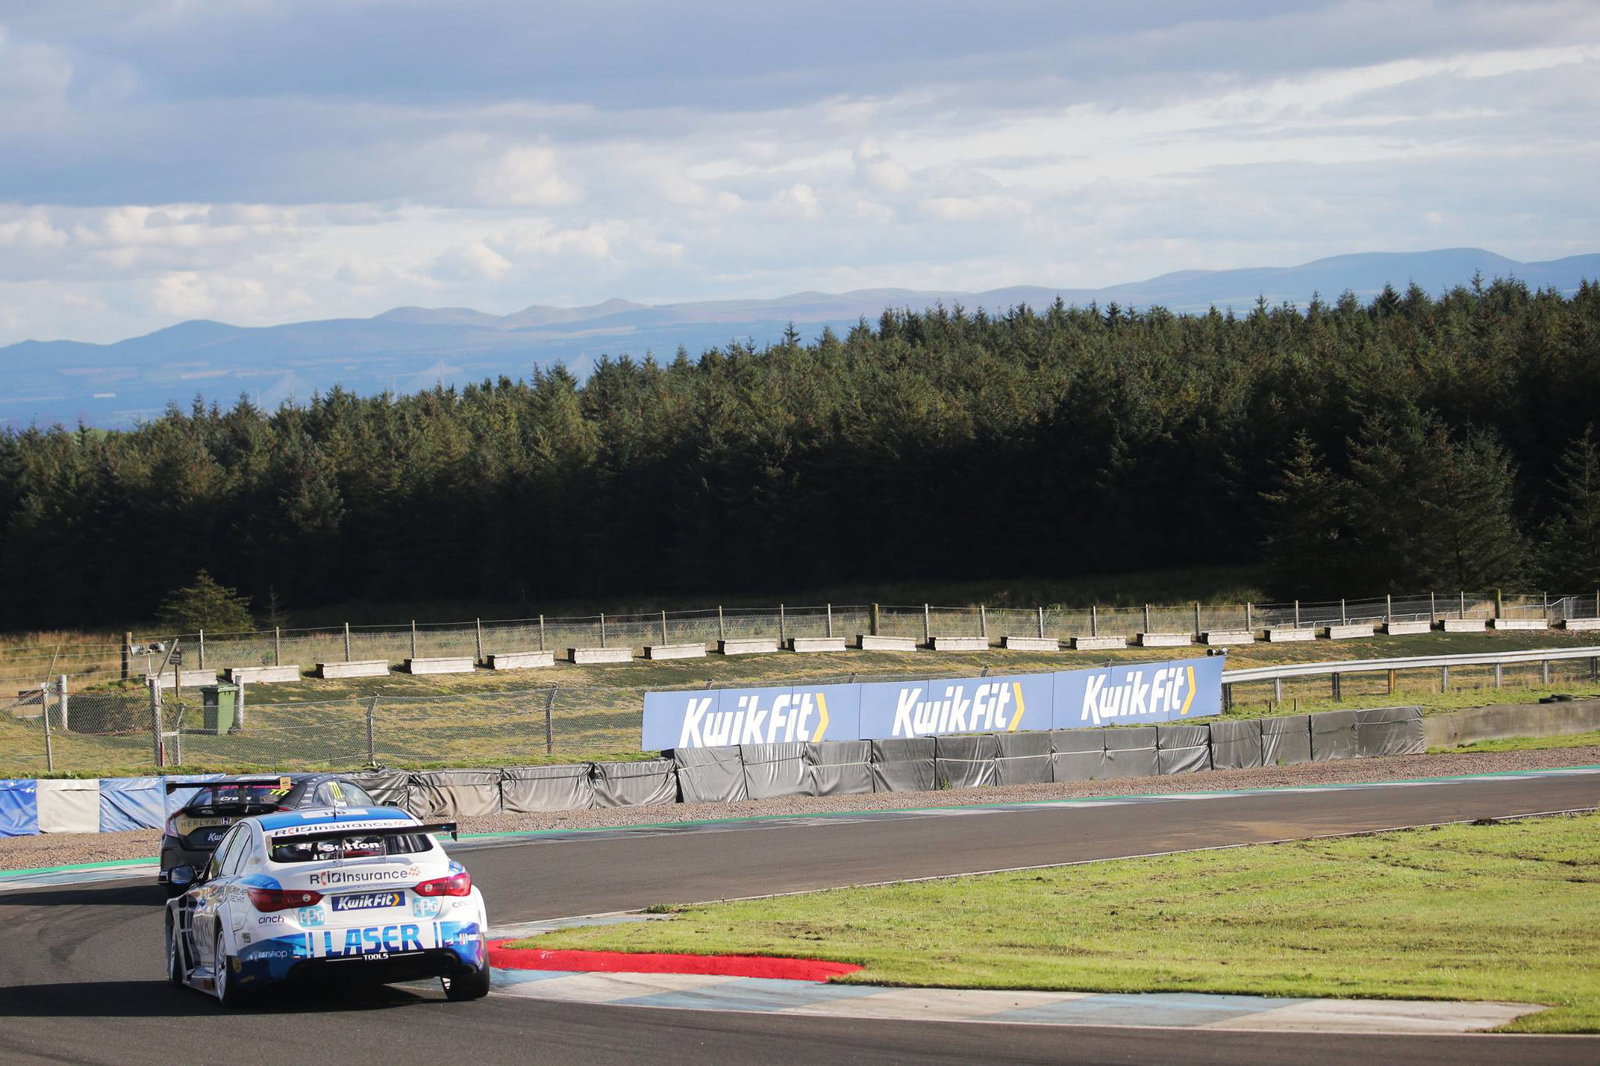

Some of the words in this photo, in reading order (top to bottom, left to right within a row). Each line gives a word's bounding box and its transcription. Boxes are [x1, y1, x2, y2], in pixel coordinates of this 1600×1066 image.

[258, 915, 284, 924] cinch
[324, 924, 424, 957] LASER
[363, 953, 389, 961] TOOLS
